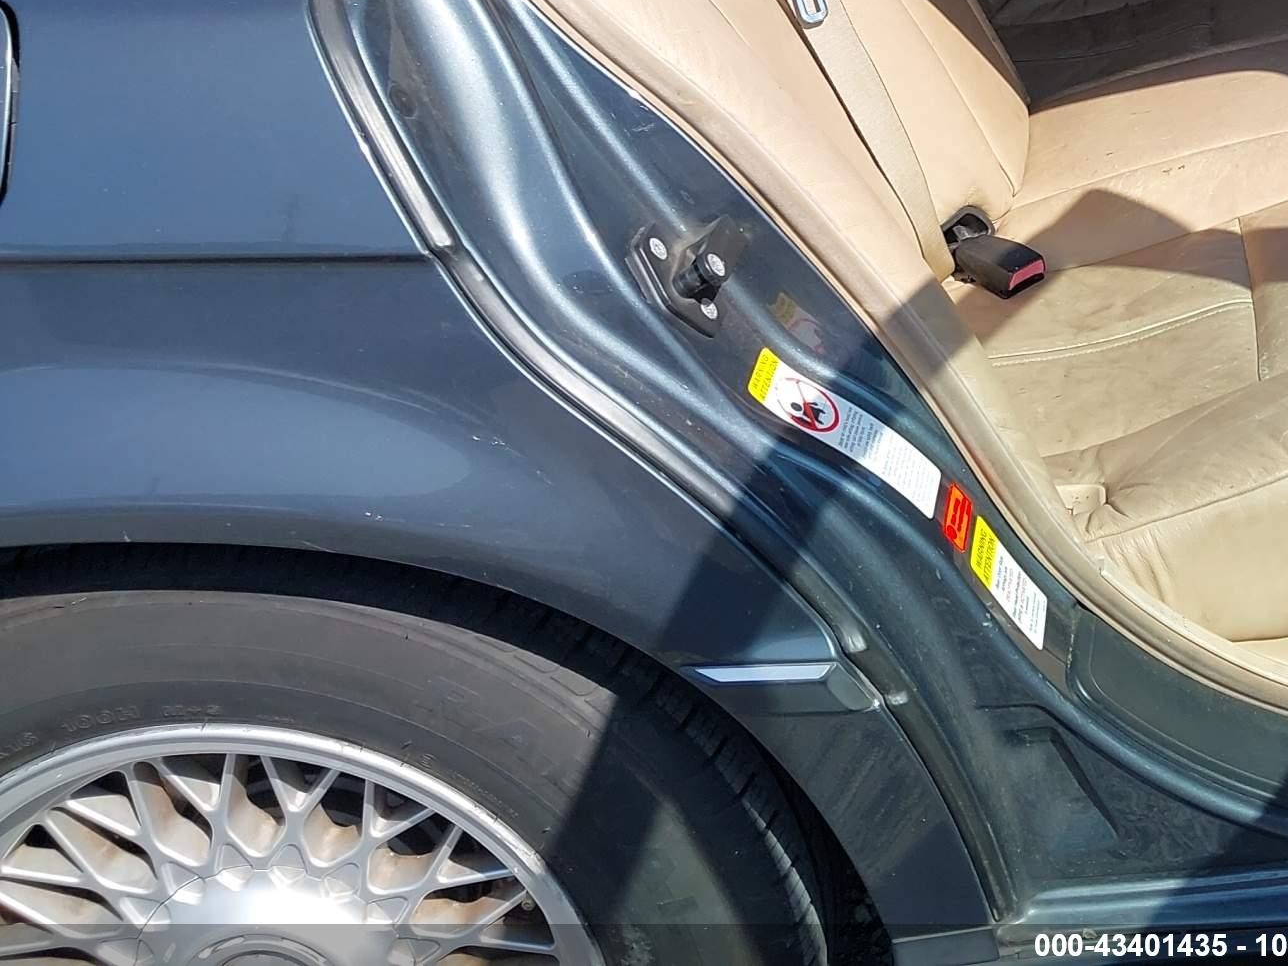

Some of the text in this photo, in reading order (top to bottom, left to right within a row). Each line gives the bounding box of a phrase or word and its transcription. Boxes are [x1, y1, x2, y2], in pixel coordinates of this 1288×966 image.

[752, 354, 769, 390] WARNING
[759, 360, 779, 400] ATTENTION
[976, 528, 988, 569] WARNING
[983, 534, 996, 586] ATTENTION
